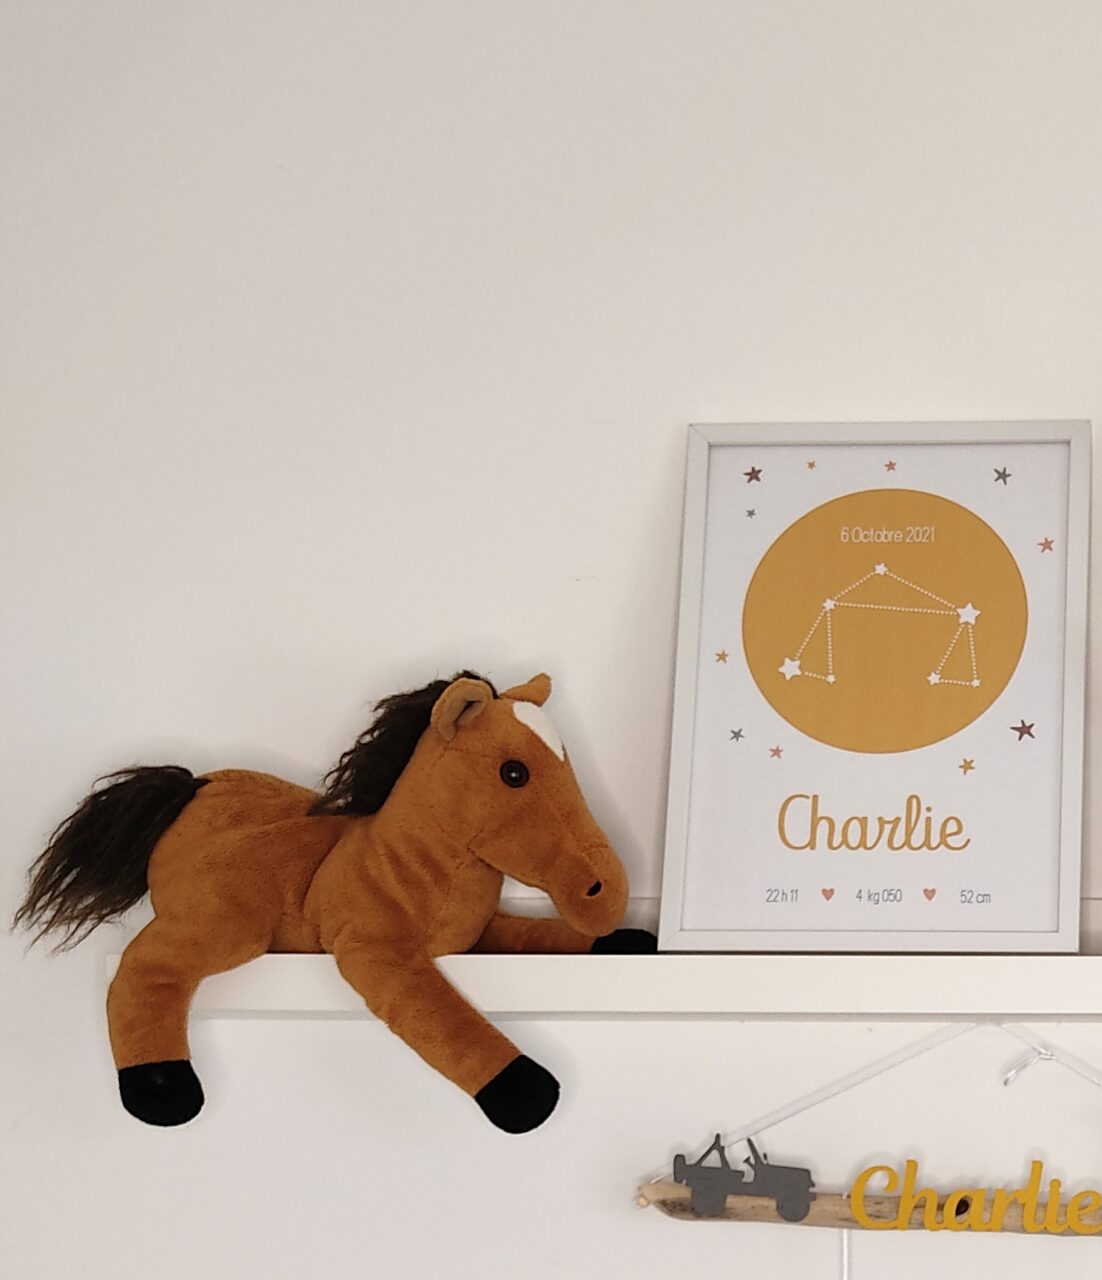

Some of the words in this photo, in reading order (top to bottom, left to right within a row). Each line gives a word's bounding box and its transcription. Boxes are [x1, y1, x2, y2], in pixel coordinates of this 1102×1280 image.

[840, 526, 850, 543] 6
[851, 526, 903, 543] Octobre
[905, 526, 935, 543] 2021
[778, 793, 971, 851] Charlie
[765, 888, 779, 903] 22
[781, 888, 788, 903] h
[790, 888, 799, 903] 11
[855, 889, 863, 902] 4
[867, 889, 880, 906] kg
[881, 889, 902, 903] 050
[959, 889, 974, 904] 52
[975, 892, 992, 904] cm
